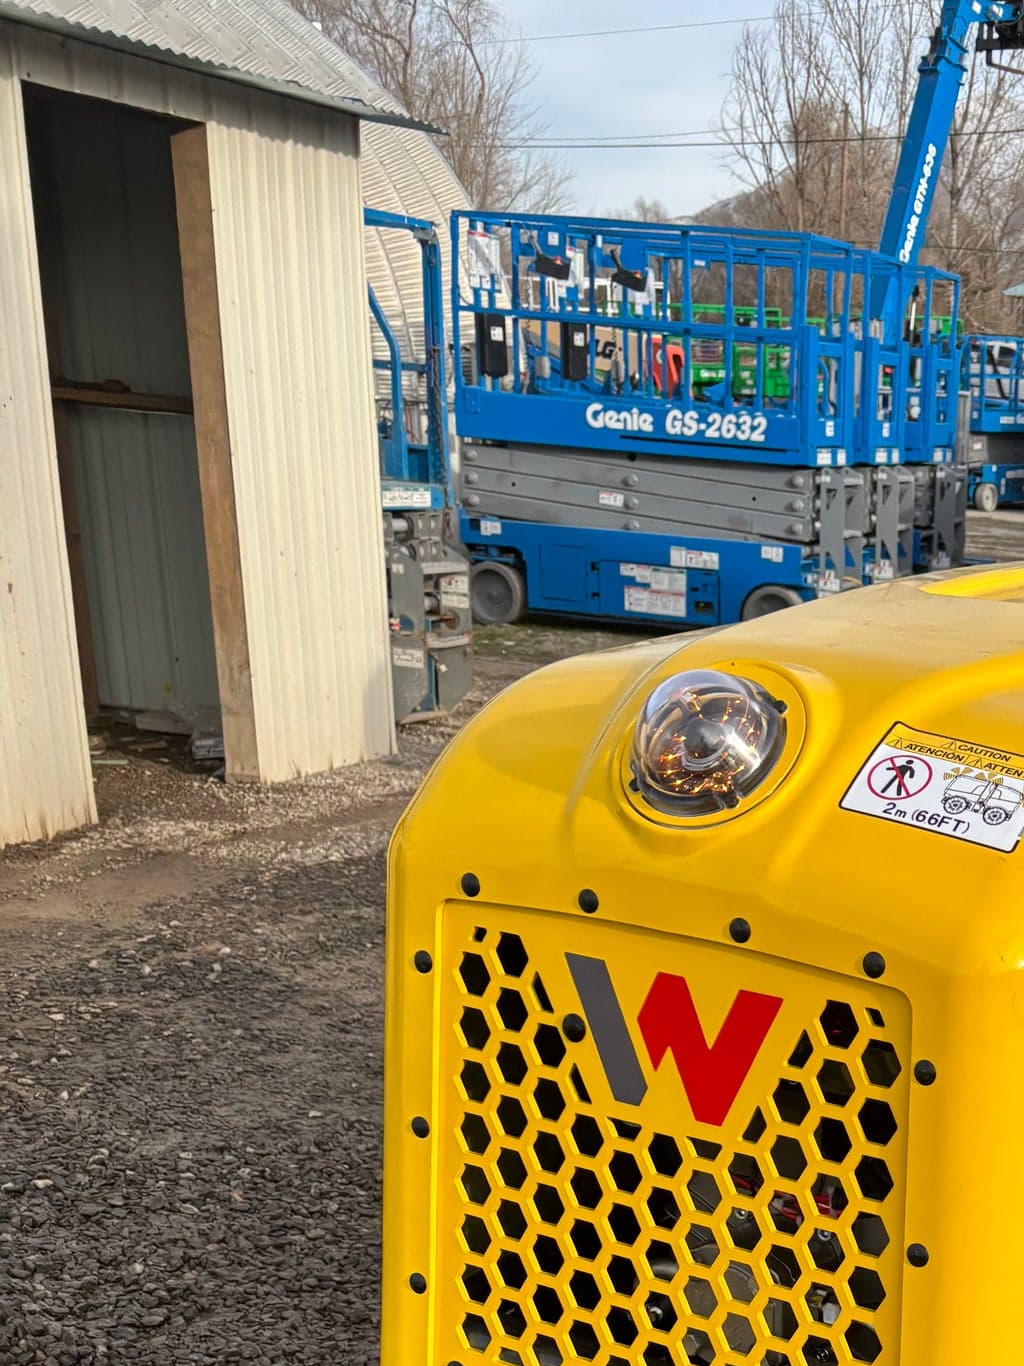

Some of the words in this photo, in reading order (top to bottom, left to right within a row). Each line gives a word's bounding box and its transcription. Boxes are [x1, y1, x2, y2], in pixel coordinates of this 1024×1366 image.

[595, 338, 616, 360] LG
[585, 402, 654, 433] Genie
[665, 409, 768, 442] GS-2632
[904, 742, 966, 763] ATENCIÓN
[957, 743, 1012, 763] CAUTION
